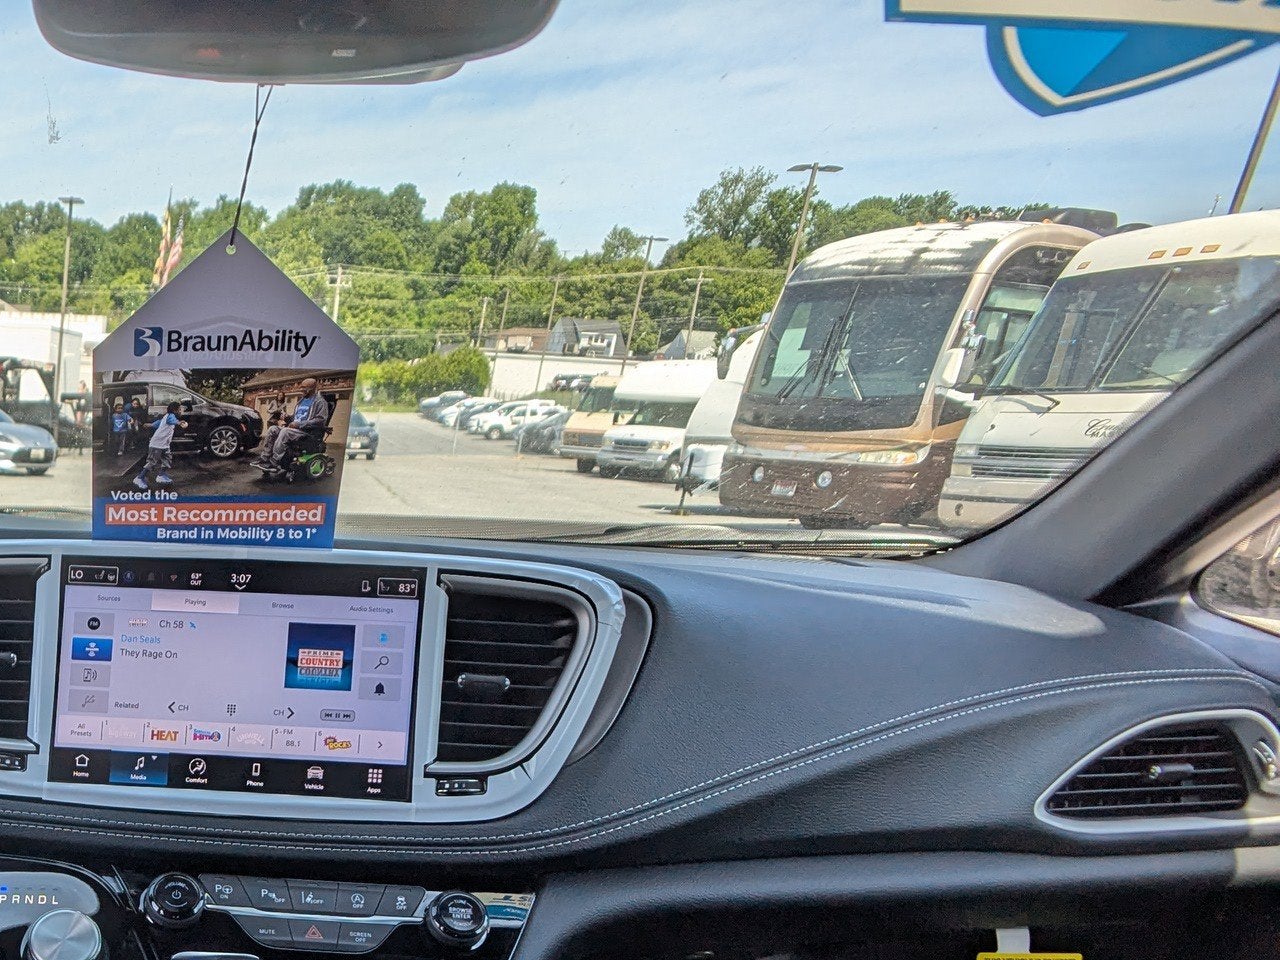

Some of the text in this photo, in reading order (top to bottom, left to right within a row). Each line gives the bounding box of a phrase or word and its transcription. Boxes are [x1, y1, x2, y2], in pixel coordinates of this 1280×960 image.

[166, 329, 317, 358] BraunAbility
[111, 490, 178, 501] Voted the
[108, 506, 322, 522] Most Recommended
[157, 527, 197, 539] Brand
[200, 527, 213, 539] in
[216, 527, 274, 541] Mobility
[276, 528, 285, 539] 8
[288, 528, 302, 539] to
[70, 570, 84, 579] LO
[230, 573, 252, 583] 3:07
[97, 594, 121, 602] Sources
[184, 598, 207, 606] Playing
[368, 606, 394, 614] Settings
[159, 619, 171, 629] Ch
[173, 620, 184, 629] 58
[121, 634, 161, 644] Dan Seals
[120, 648, 178, 659] They Rage On
[299, 657, 341, 666] COUNTRY
[70, 730, 92, 738] Presets
[150, 729, 179, 742] HEAT
[73, 770, 89, 778] Home
[185, 776, 208, 784] Comfort
[246, 779, 264, 787] Phone
[367, 786, 381, 794] Apps
